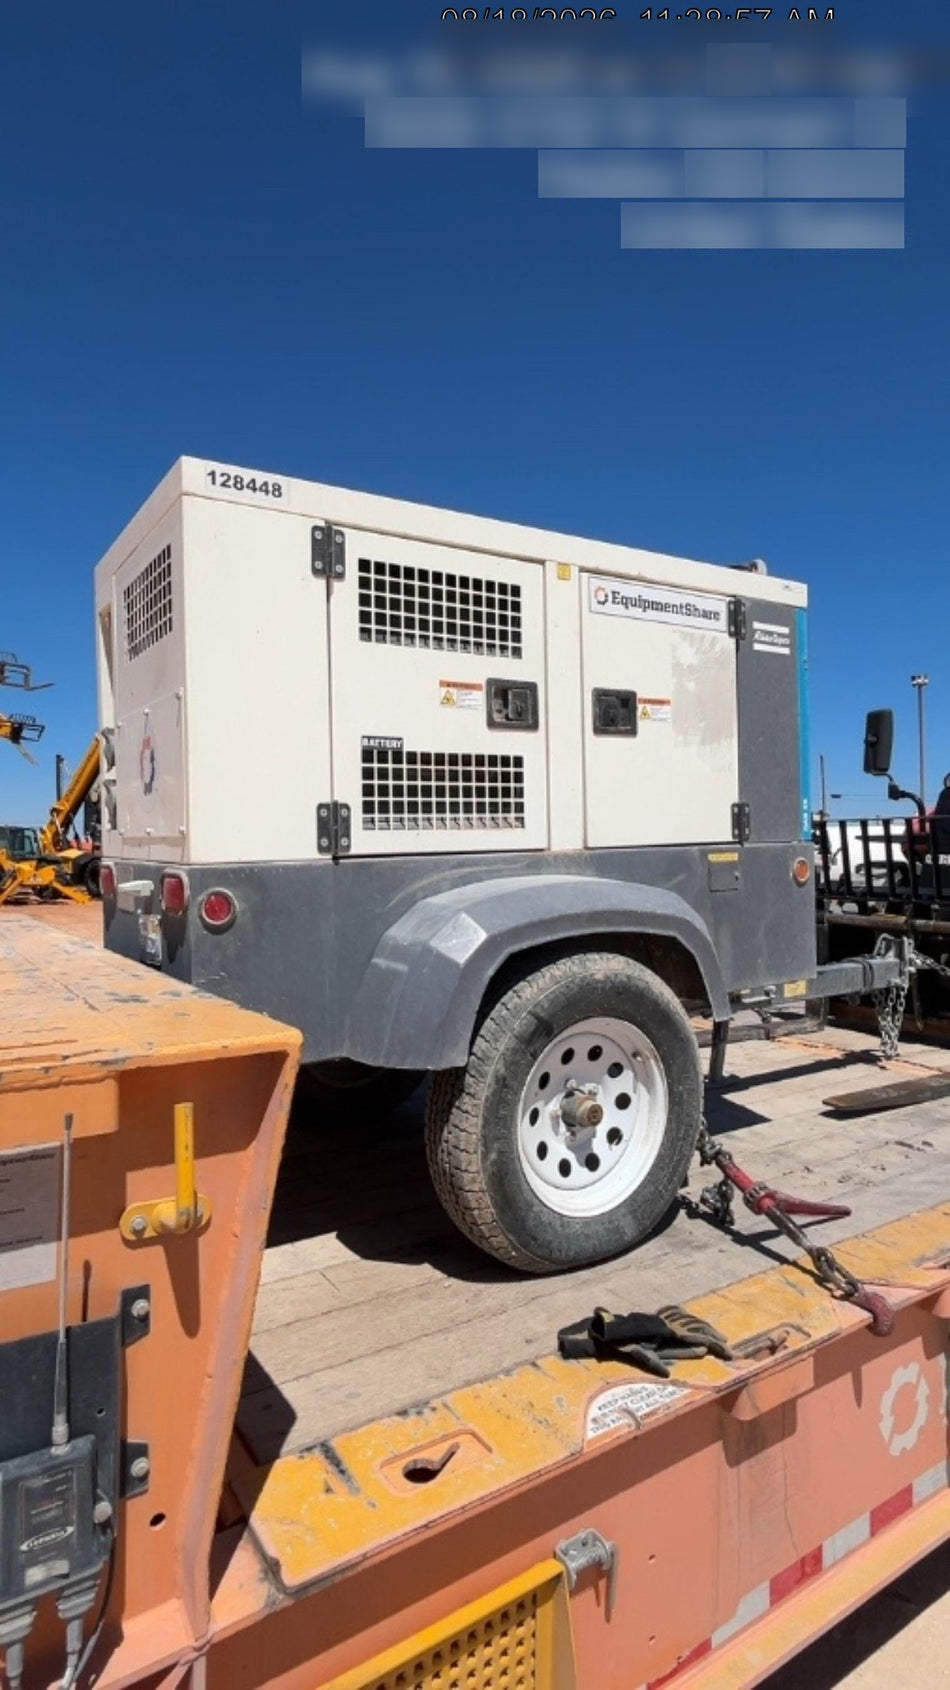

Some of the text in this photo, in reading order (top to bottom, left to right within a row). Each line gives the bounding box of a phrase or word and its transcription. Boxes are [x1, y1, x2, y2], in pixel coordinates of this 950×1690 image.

[207, 469, 282, 498] 128448
[611, 590, 721, 621] EquipmentShare
[361, 737, 403, 748] BATTERY
